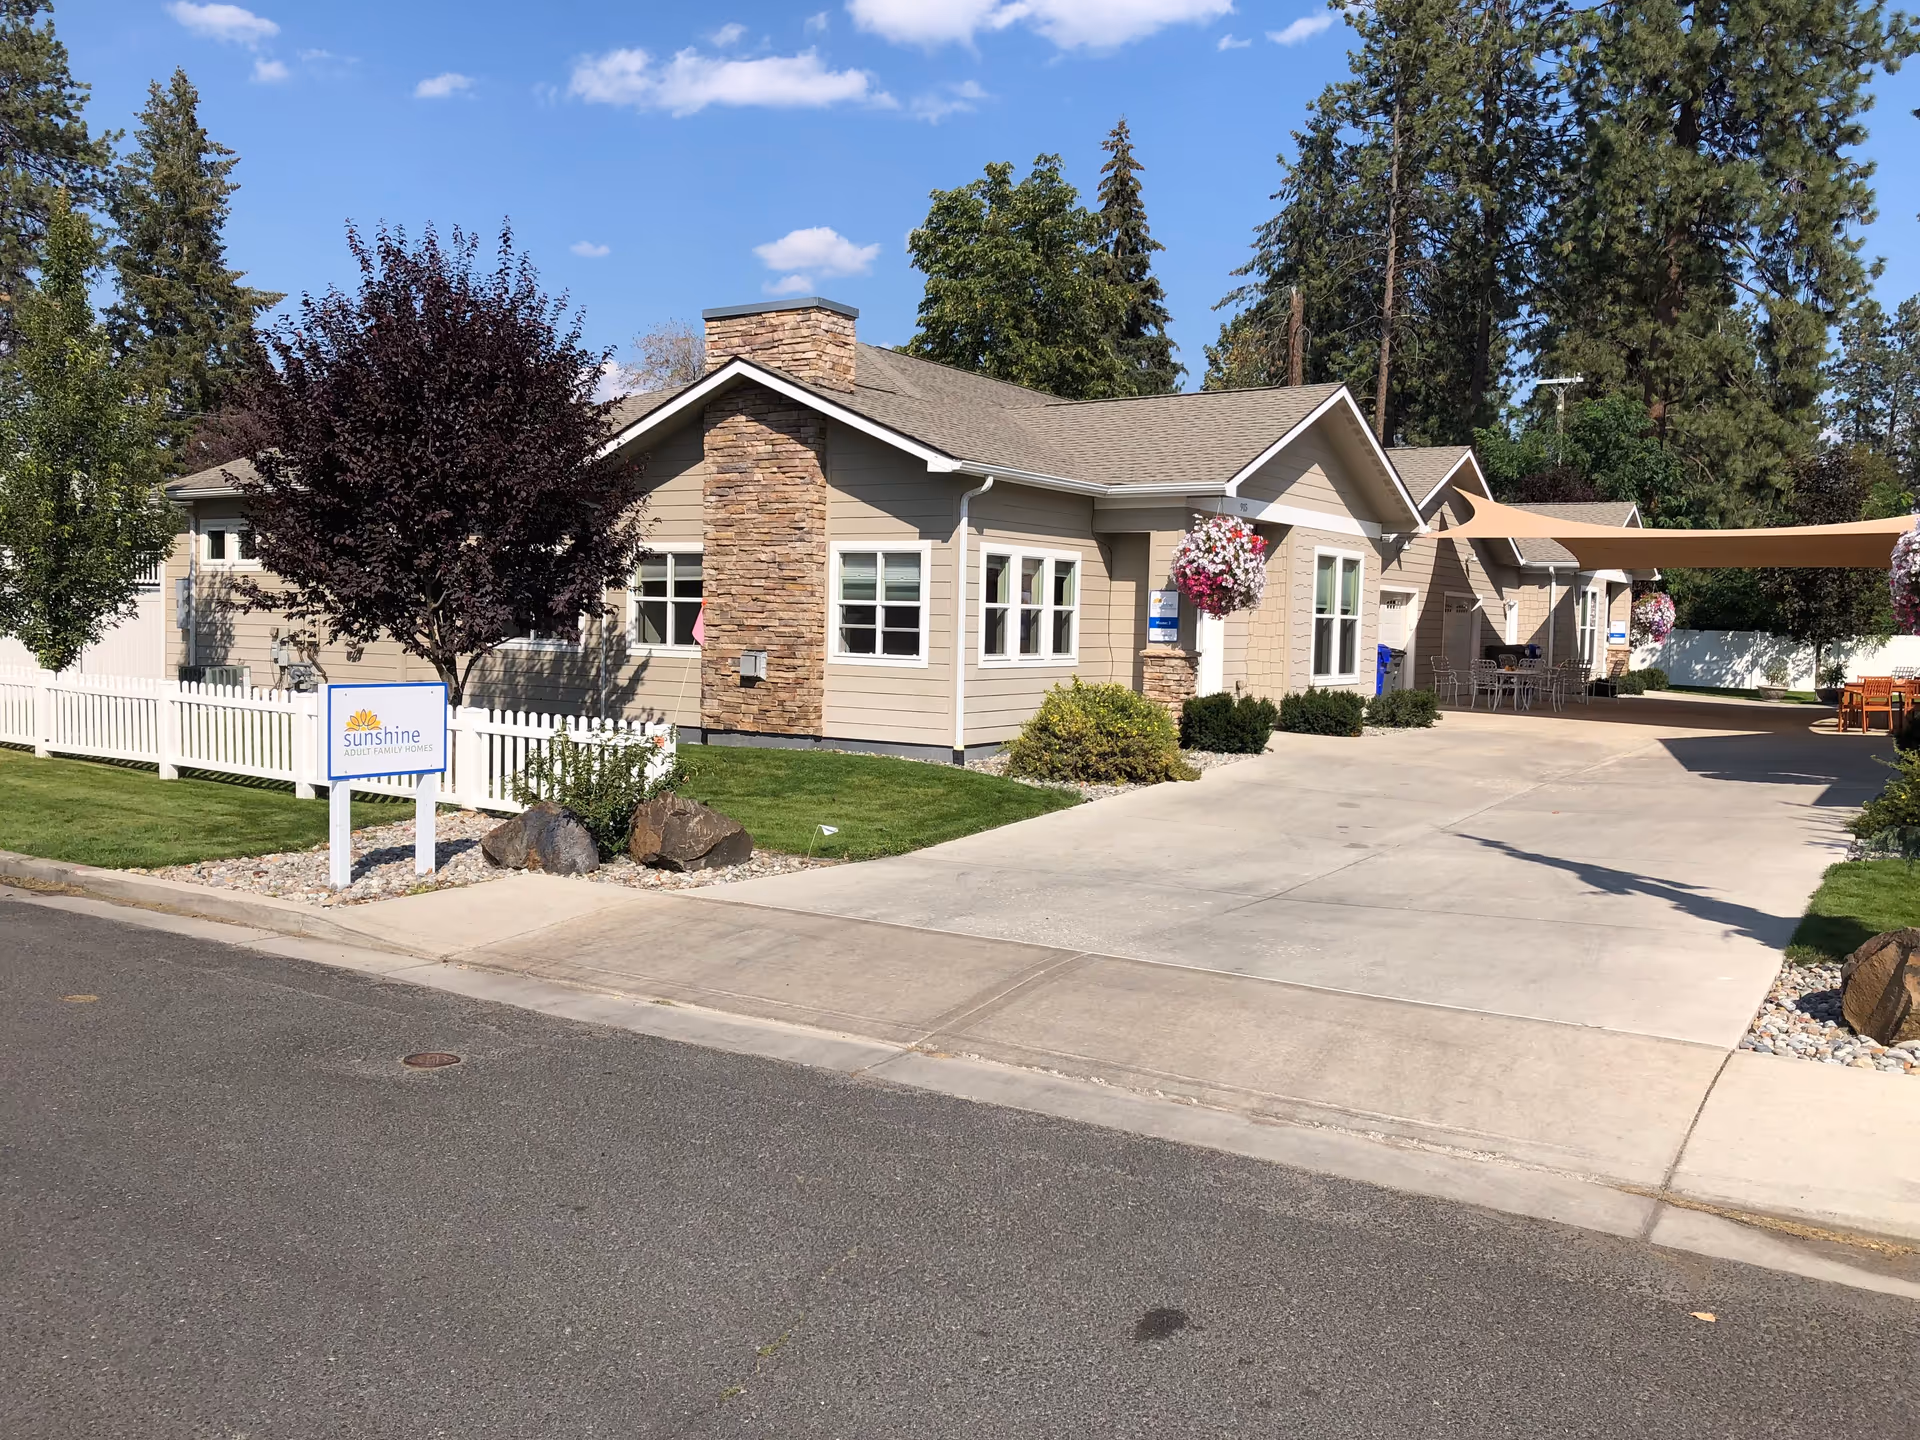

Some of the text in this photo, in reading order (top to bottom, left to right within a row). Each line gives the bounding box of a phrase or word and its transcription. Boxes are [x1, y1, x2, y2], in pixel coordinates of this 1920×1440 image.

[344, 726, 420, 747] sunshine
[344, 744, 433, 757] ADULT FAMILY HOMES
